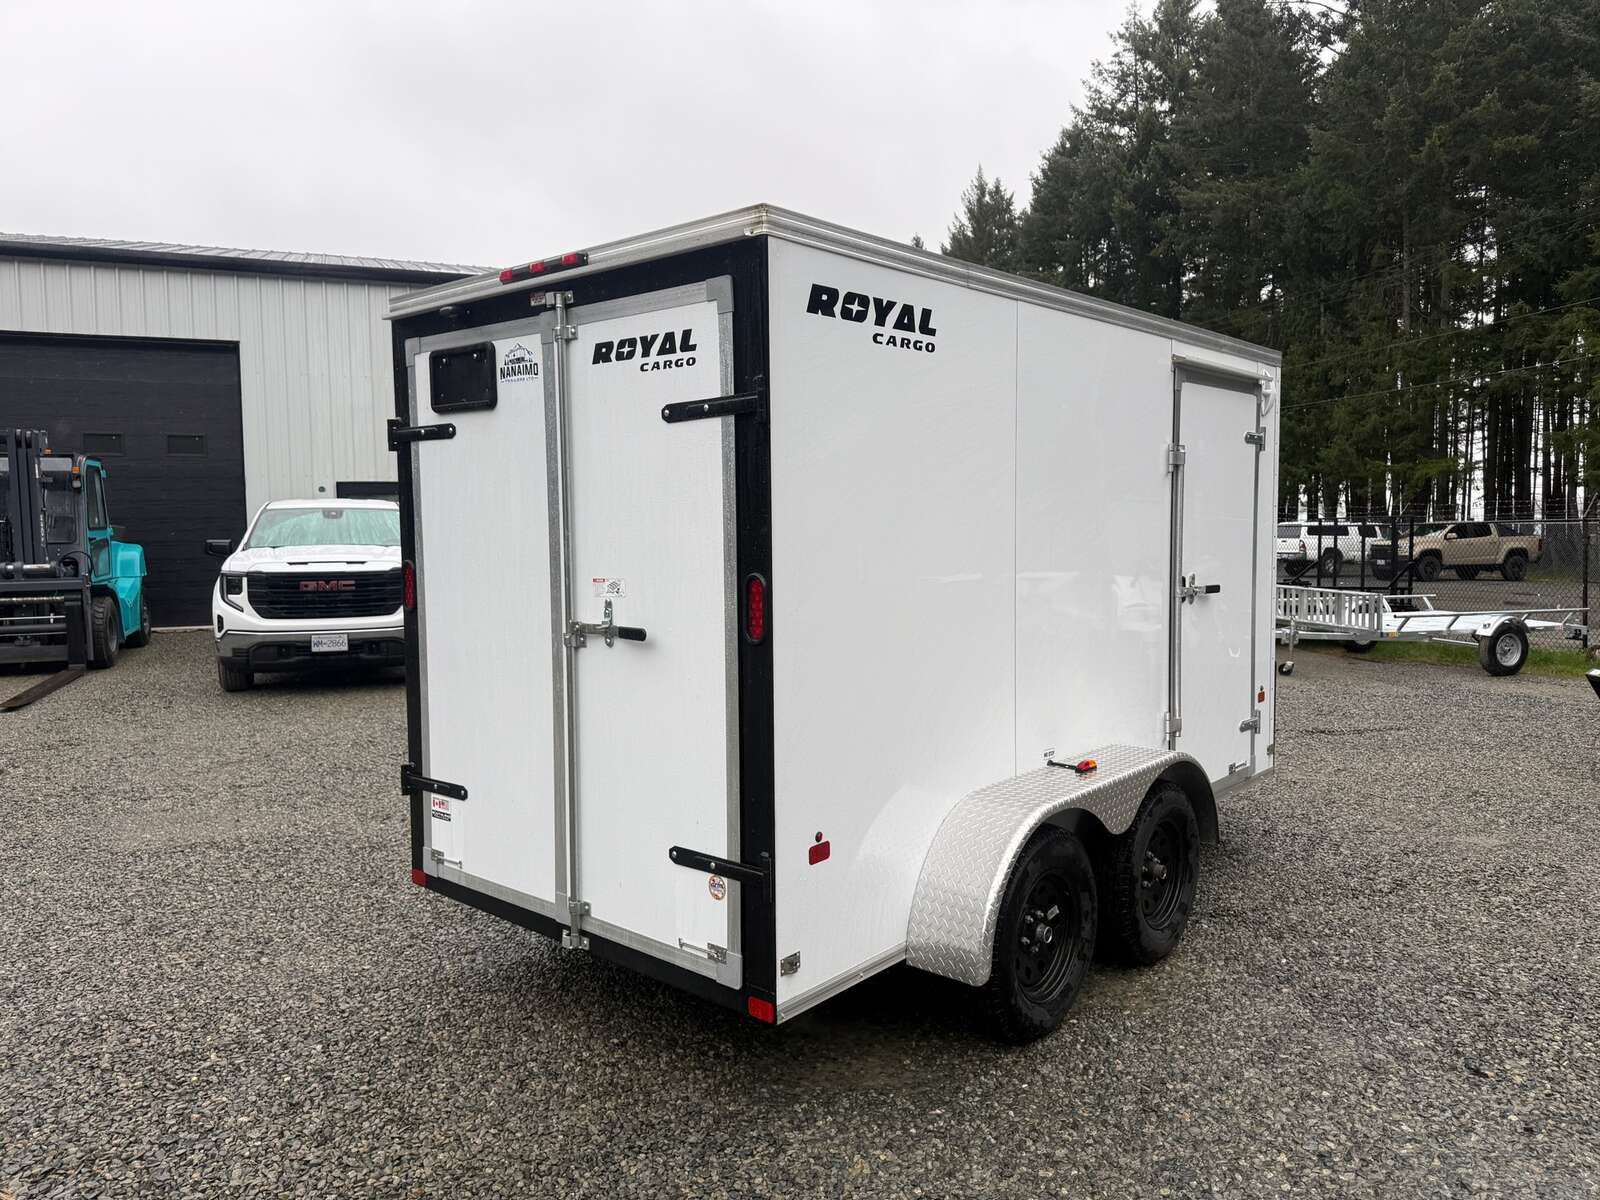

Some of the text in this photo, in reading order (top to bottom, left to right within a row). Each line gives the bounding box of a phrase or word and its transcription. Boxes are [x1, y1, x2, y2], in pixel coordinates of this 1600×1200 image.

[806, 283, 937, 336] ROYAL
[591, 328, 698, 365] ROYAL
[872, 332, 936, 353] CARGO
[500, 362, 539, 380] NANAIMO
[639, 356, 697, 372] CARGO
[299, 580, 356, 592] GMC
